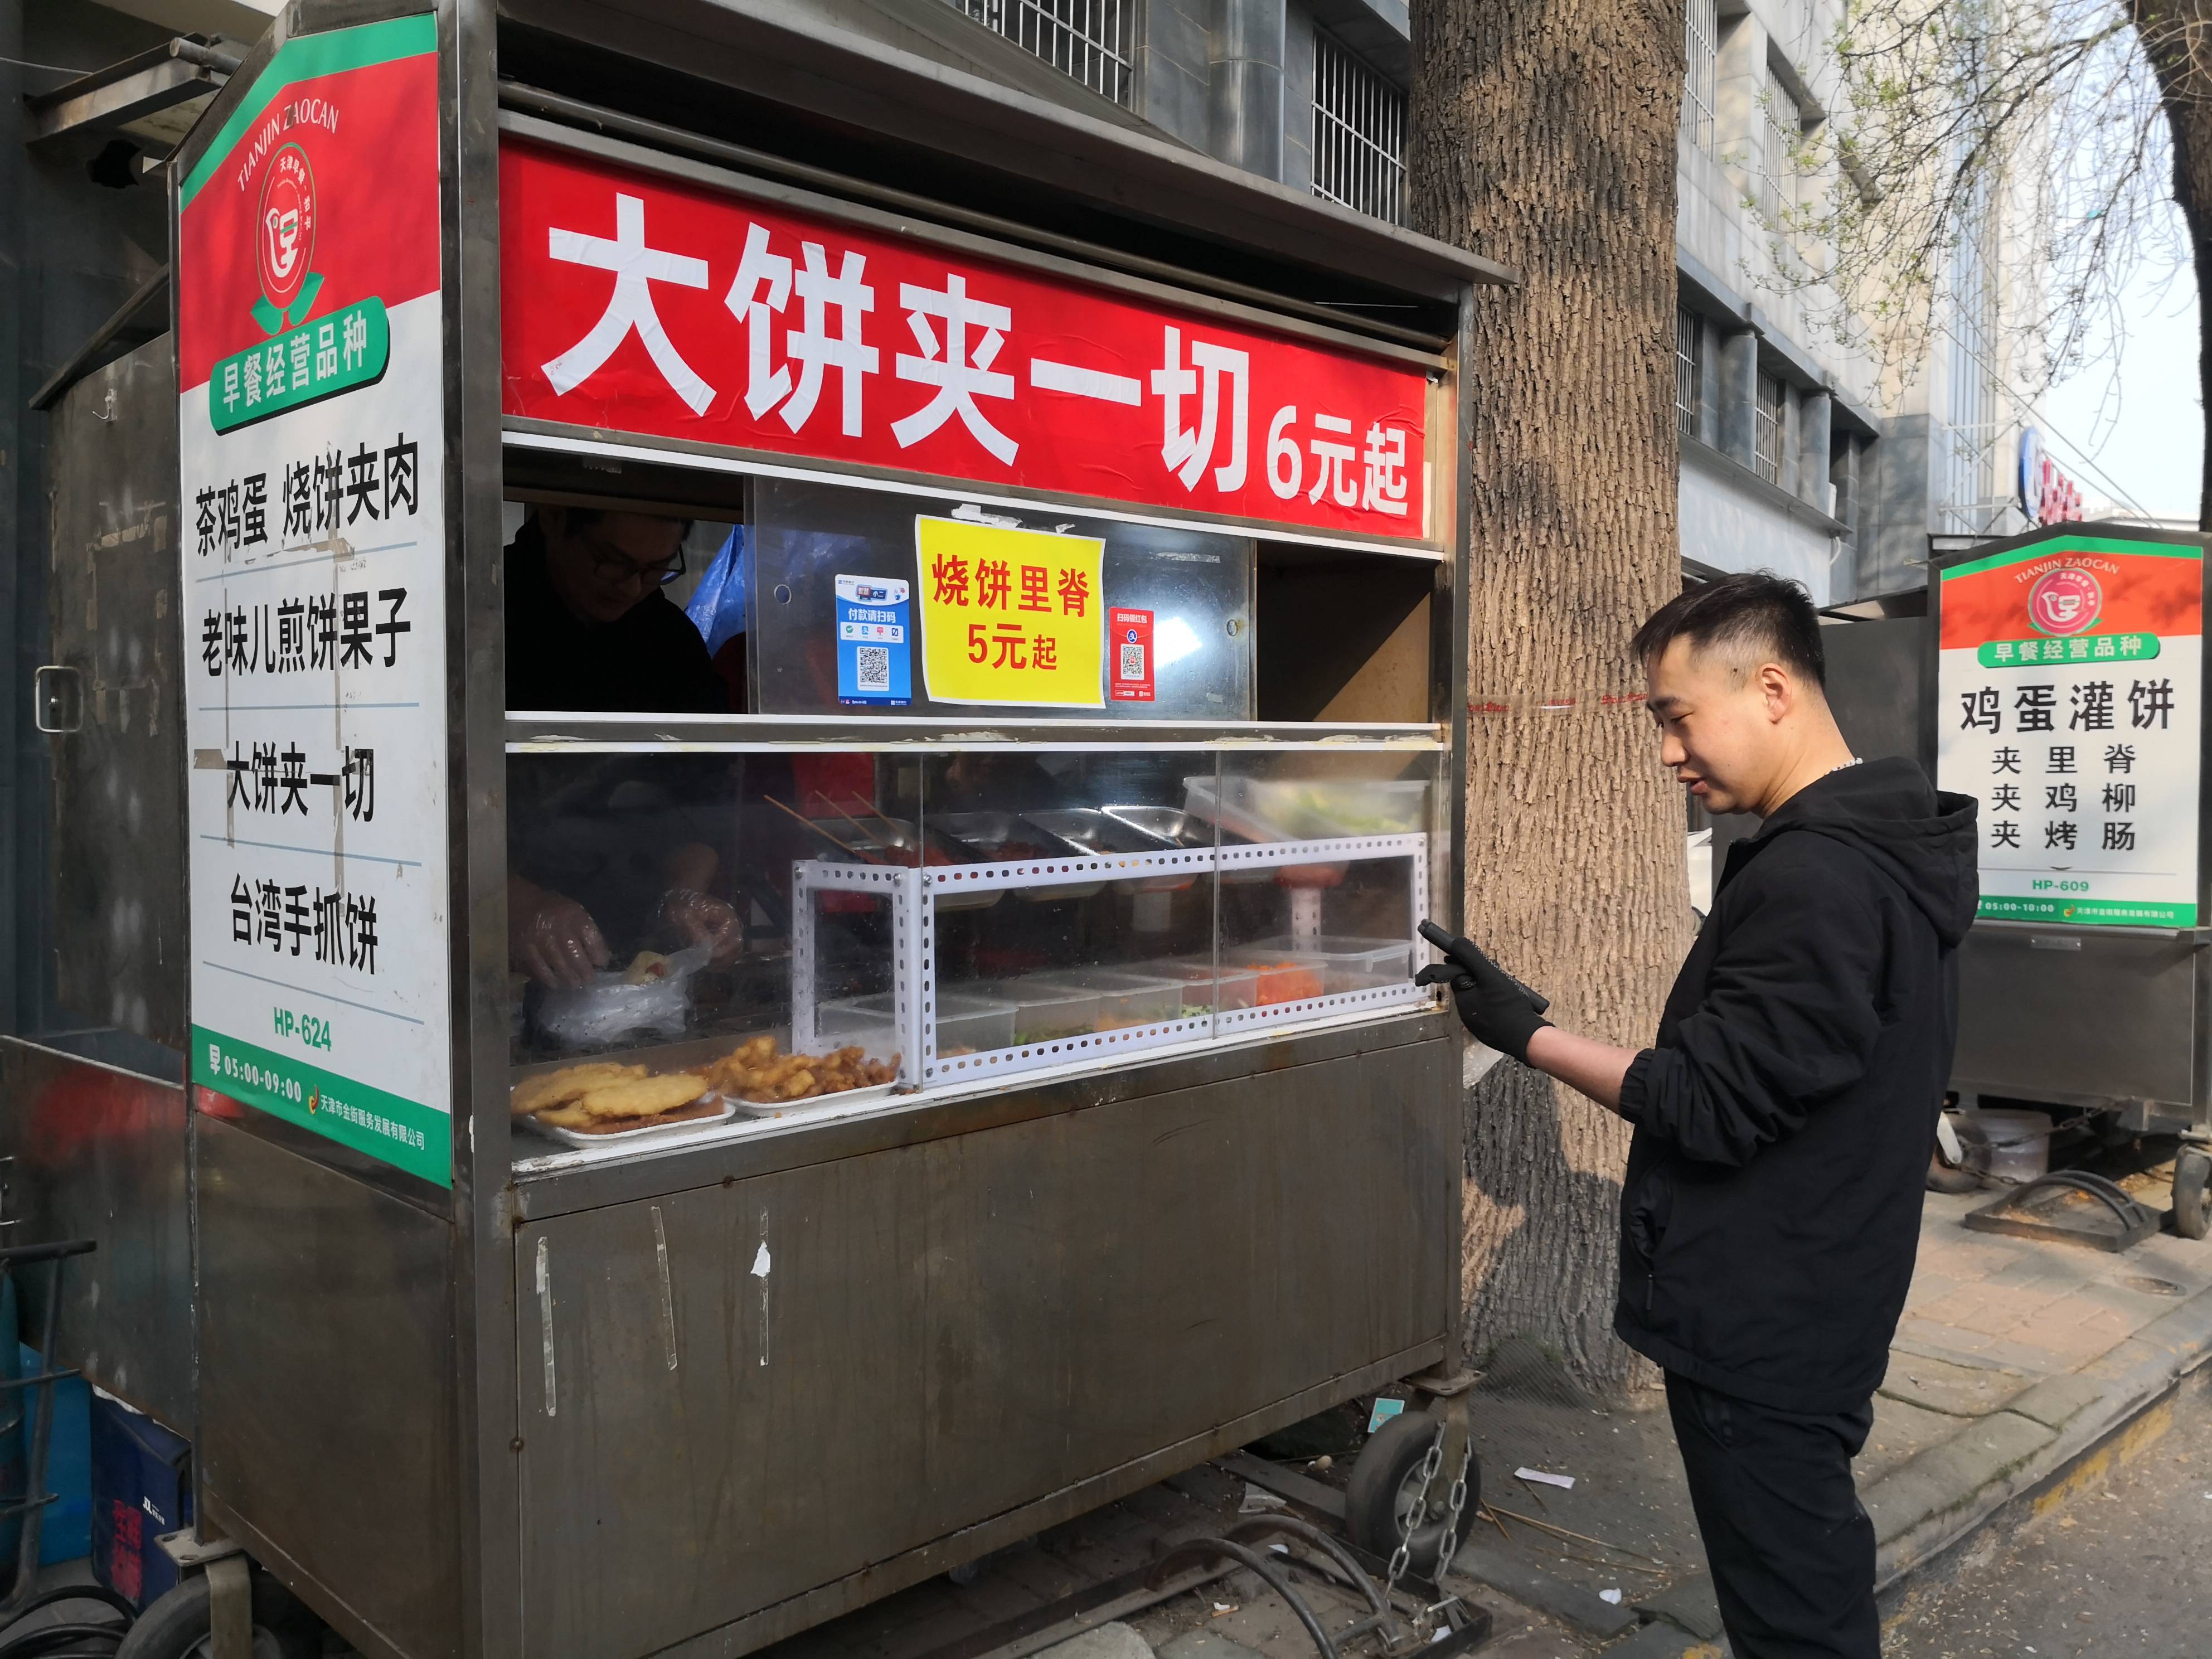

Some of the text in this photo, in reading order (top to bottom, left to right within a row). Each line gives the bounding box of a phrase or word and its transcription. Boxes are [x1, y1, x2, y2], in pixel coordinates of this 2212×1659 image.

[237, 99, 338, 191] TIANJIN ZAOCAN
[223, 310, 367, 413] 早餐经营品种
[541, 192, 1408, 515] 大饼夹一切 6元起
[196, 433, 418, 557] 茶鸡蛋 烧饼夹肉
[932, 554, 1090, 618] 烧饼里脊
[2014, 557, 2120, 583] TIANJIN ZAOCAN
[202, 588, 411, 677] 老味儿煎饼果子
[848, 608, 896, 623] 付款请扫码
[1117, 613, 1147, 623] 扫码领红包
[968, 623, 1058, 670] 5元起
[1995, 635, 2142, 662] 早餐经营品种
[1961, 678, 2174, 734] 鸡蛋灌饼
[227, 740, 374, 822] 大饼夹一切
[1992, 744, 2136, 774] 夹里脊
[1991, 783, 2136, 813] 夹鸡柳
[1991, 820, 2136, 851] 夹烤肠
[1985, 902, 2054, 912] 05:00-10:00
[2032, 880, 2089, 891] HP-609
[231, 873, 378, 975] 台湾手抓饼
[274, 1007, 332, 1051] HP-624
[209, 1044, 424, 1150] 早 05:00-09:00 天津市金街服务发展有限公司
